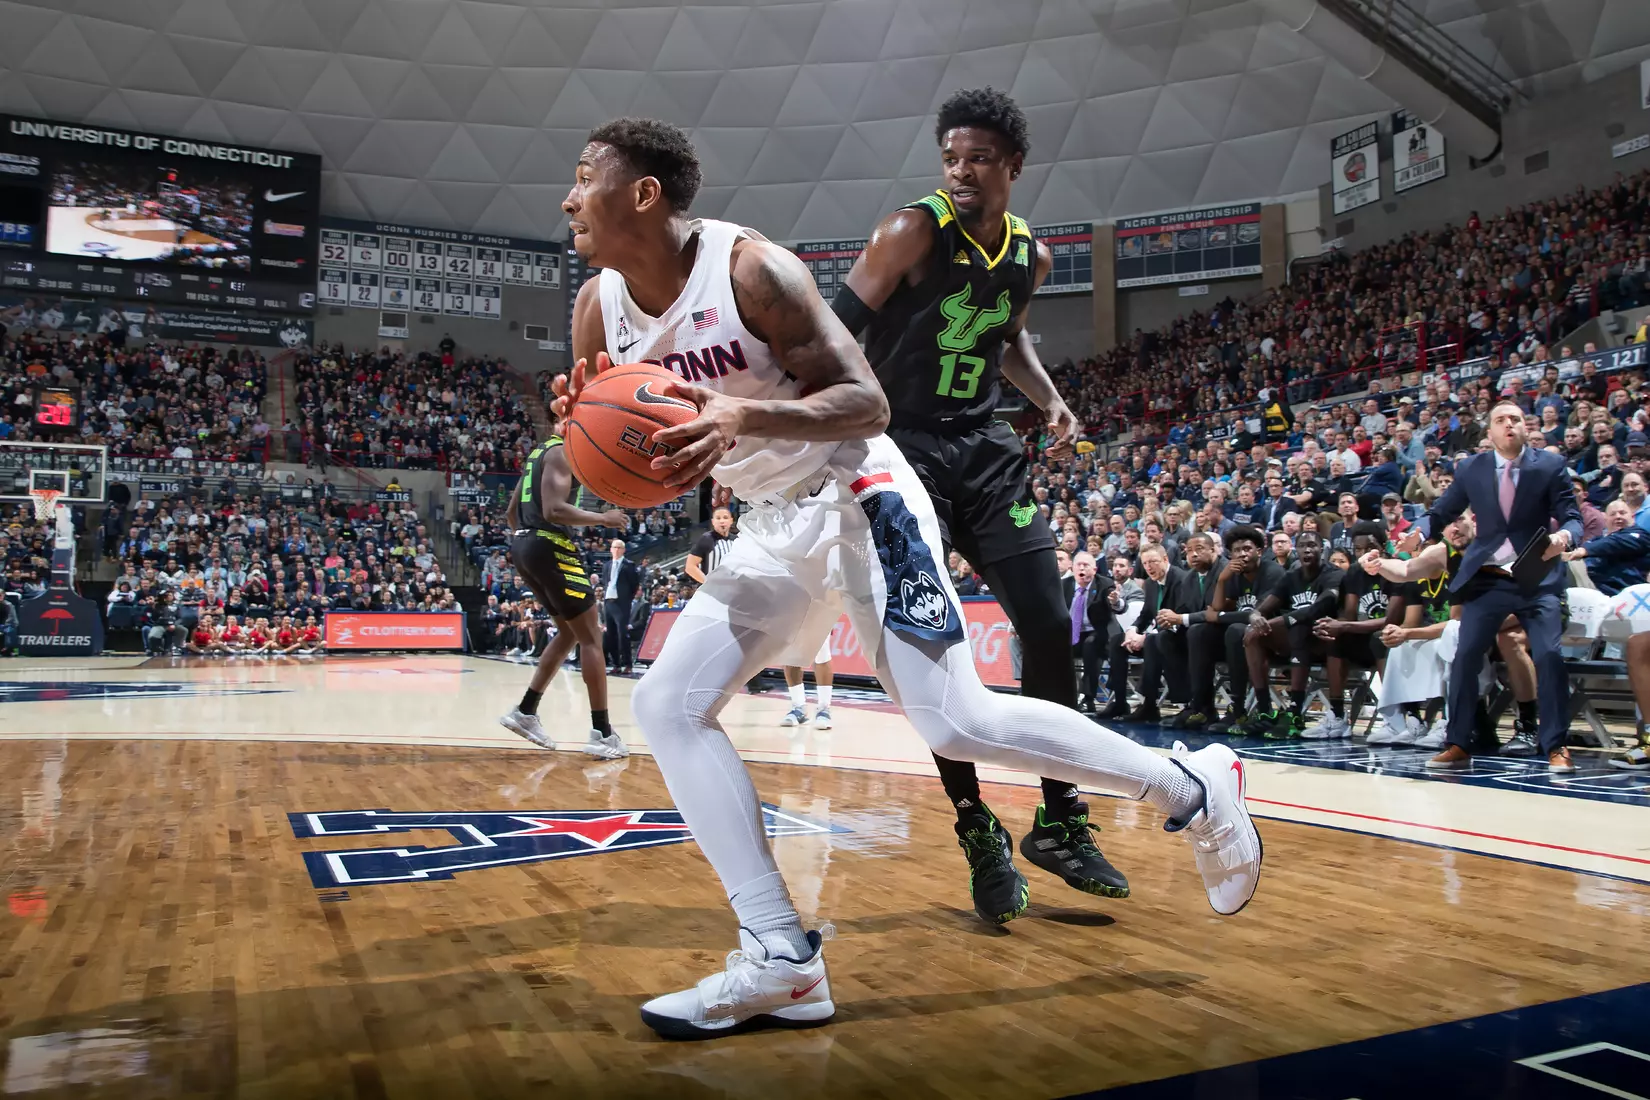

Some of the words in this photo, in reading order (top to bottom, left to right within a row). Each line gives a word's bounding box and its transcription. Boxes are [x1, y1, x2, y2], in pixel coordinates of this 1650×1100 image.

[10, 120, 130, 148] UNIVERSITY
[134, 135, 160, 151] OF
[163, 140, 294, 169] CONNECTICUT
[1124, 218, 1156, 228] NCAA
[1160, 205, 1253, 224] CHAMPIONSHIP
[376, 224, 410, 234] UCONN
[414, 228, 457, 239] HUSKIES
[462, 233, 474, 241] OF
[479, 236, 510, 245] HONOR
[1034, 225, 1084, 236] PIONSHIP
[324, 245, 345, 260] 52
[804, 243, 834, 252] NCAA
[387, 252, 408, 266] 00
[420, 255, 437, 269] 13
[448, 259, 469, 273] 42
[482, 262, 495, 275] 34
[512, 265, 524, 279] 32
[540, 268, 553, 282] 50
[328, 283, 339, 298] 15
[358, 287, 371, 301] 22
[420, 292, 433, 307] 42
[451, 295, 464, 309] 13
[640, 339, 749, 383] ONN
[1611, 348, 1641, 366] 121
[935, 353, 986, 399] 13
[620, 425, 678, 465] ELIT
[160, 483, 179, 492] 116
[392, 492, 409, 501] 116
[475, 495, 491, 504] 117
[669, 502, 683, 512] 117
[18, 635, 92, 646] TRAVELERS
